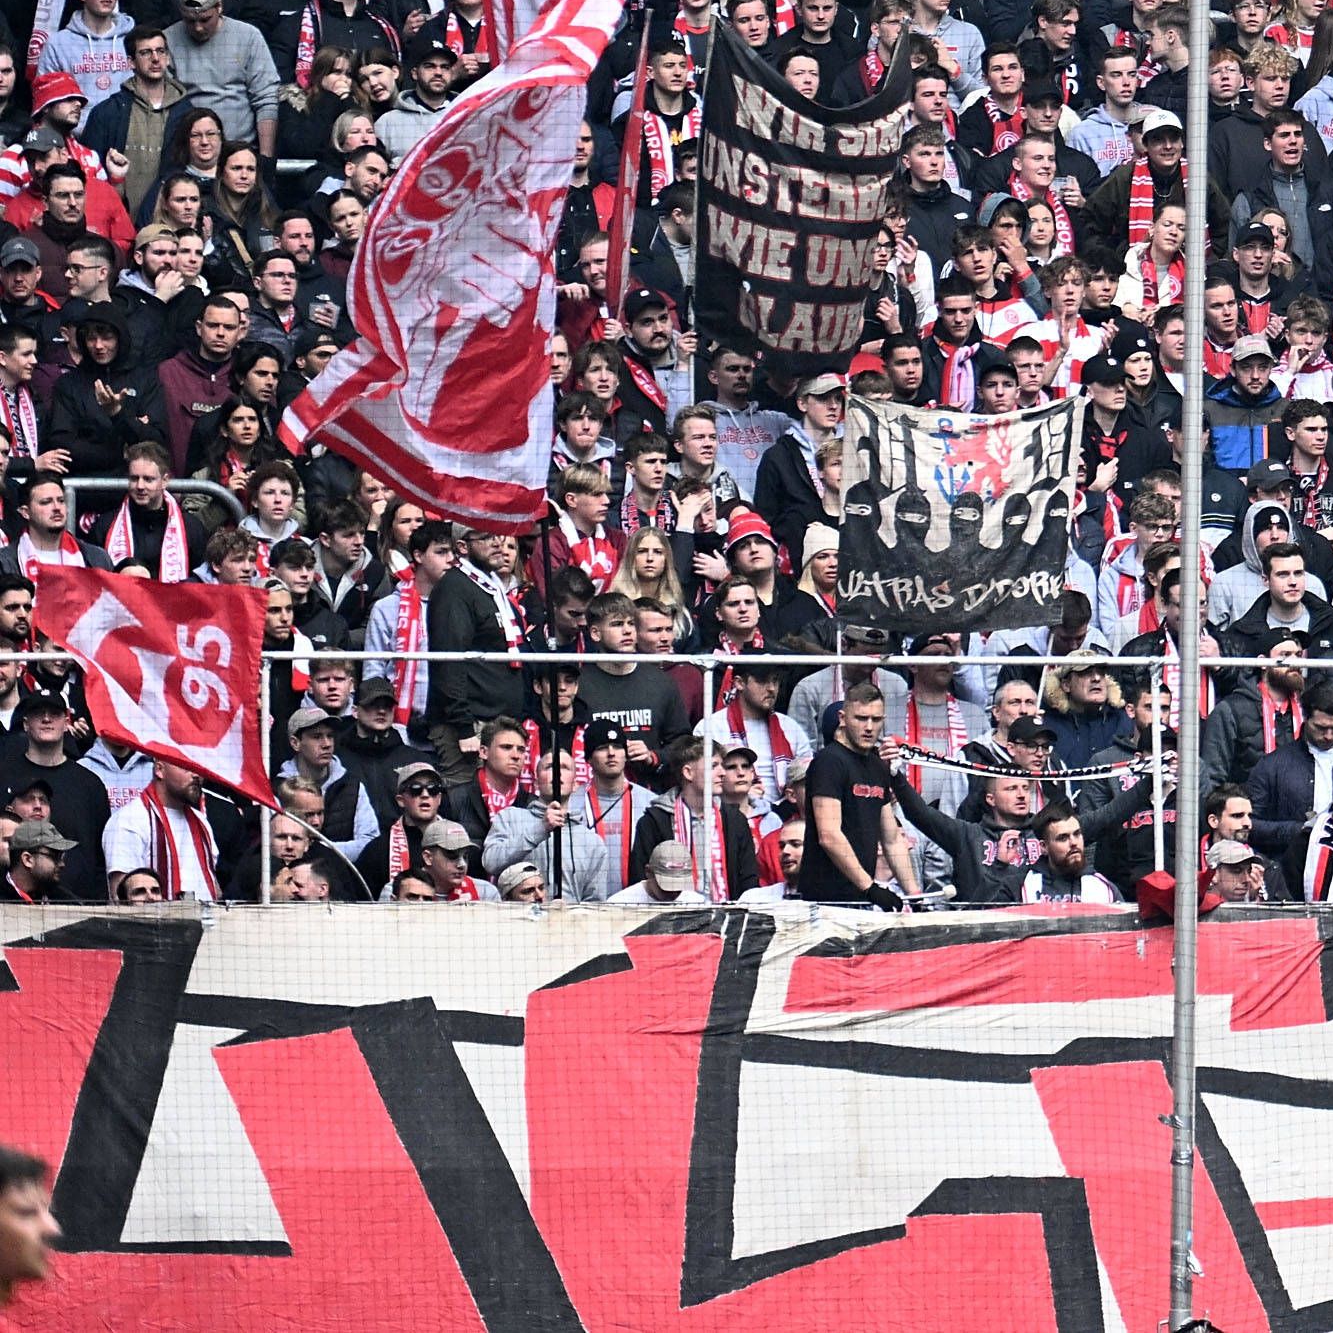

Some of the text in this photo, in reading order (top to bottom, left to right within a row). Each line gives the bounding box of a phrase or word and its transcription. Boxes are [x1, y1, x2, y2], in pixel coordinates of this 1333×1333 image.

[732, 74, 826, 152] WIR
[838, 103, 912, 157] SIN
[706, 204, 799, 282] WIE
